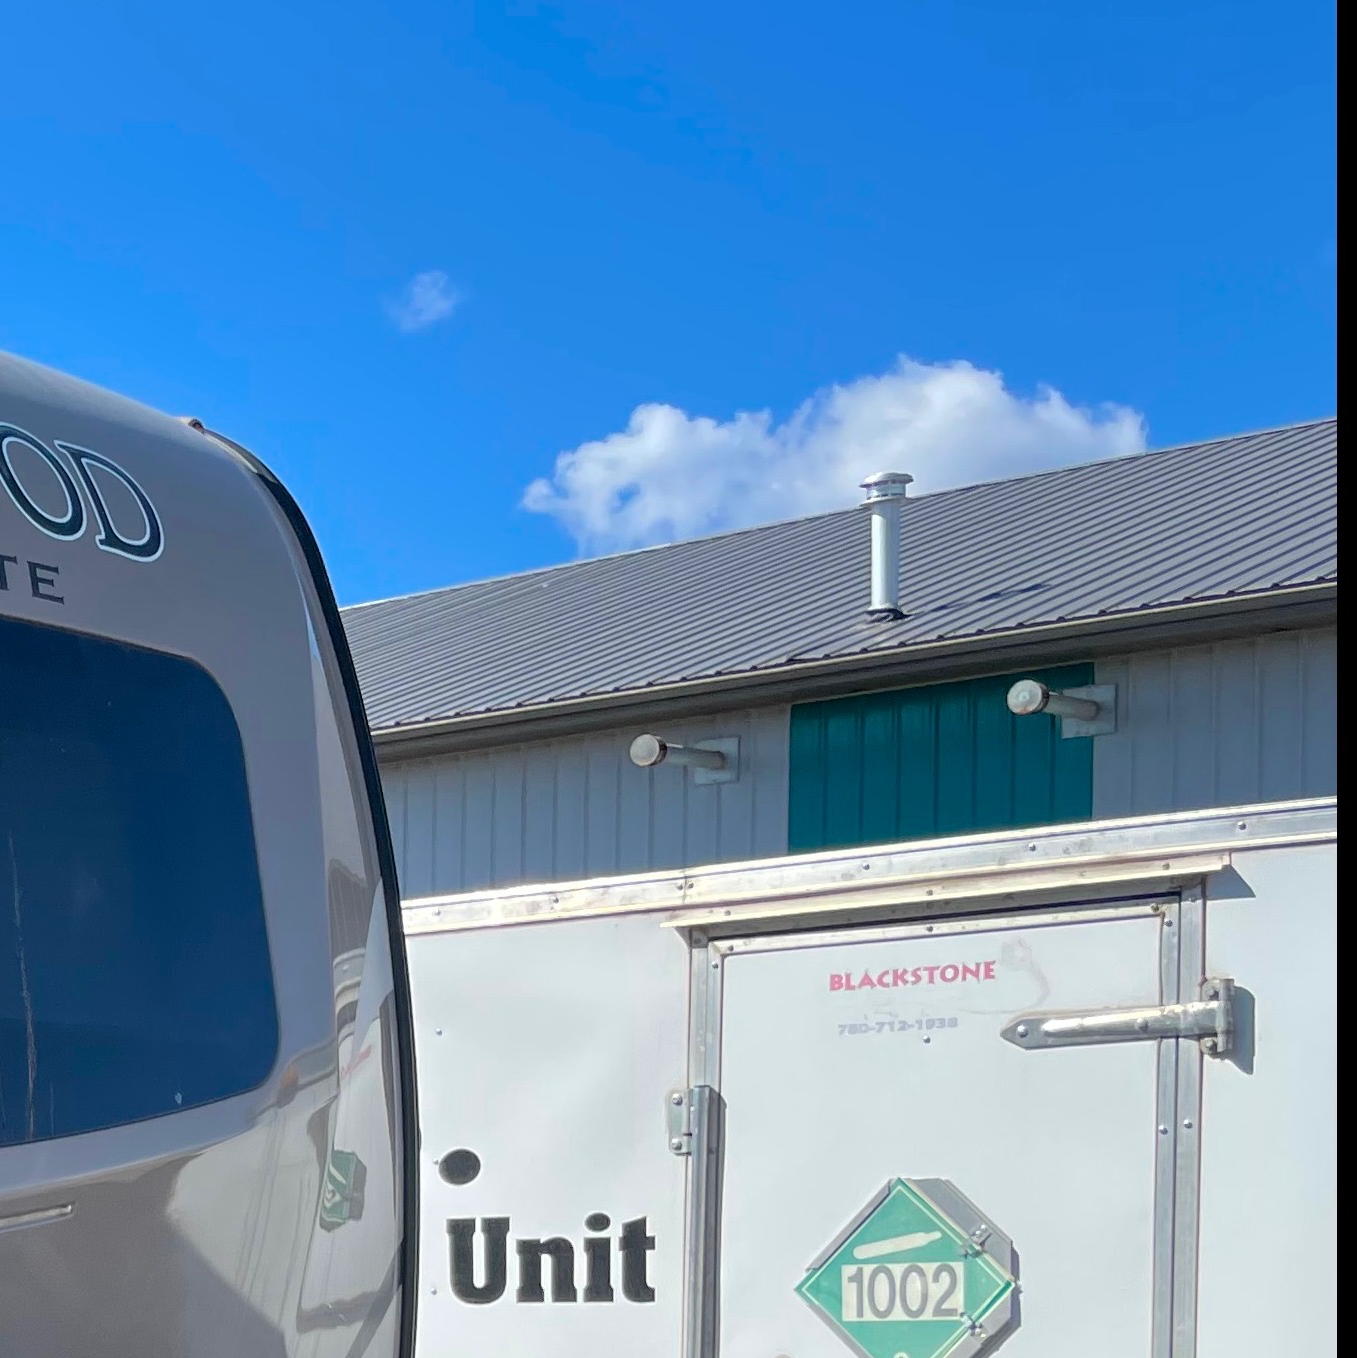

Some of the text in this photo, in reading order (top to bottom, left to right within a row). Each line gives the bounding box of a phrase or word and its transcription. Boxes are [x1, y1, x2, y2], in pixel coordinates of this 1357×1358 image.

[828, 960, 997, 992] BLACKSTONE
[445, 1210, 656, 1305] Unit
[847, 1263, 958, 1319] 1002
